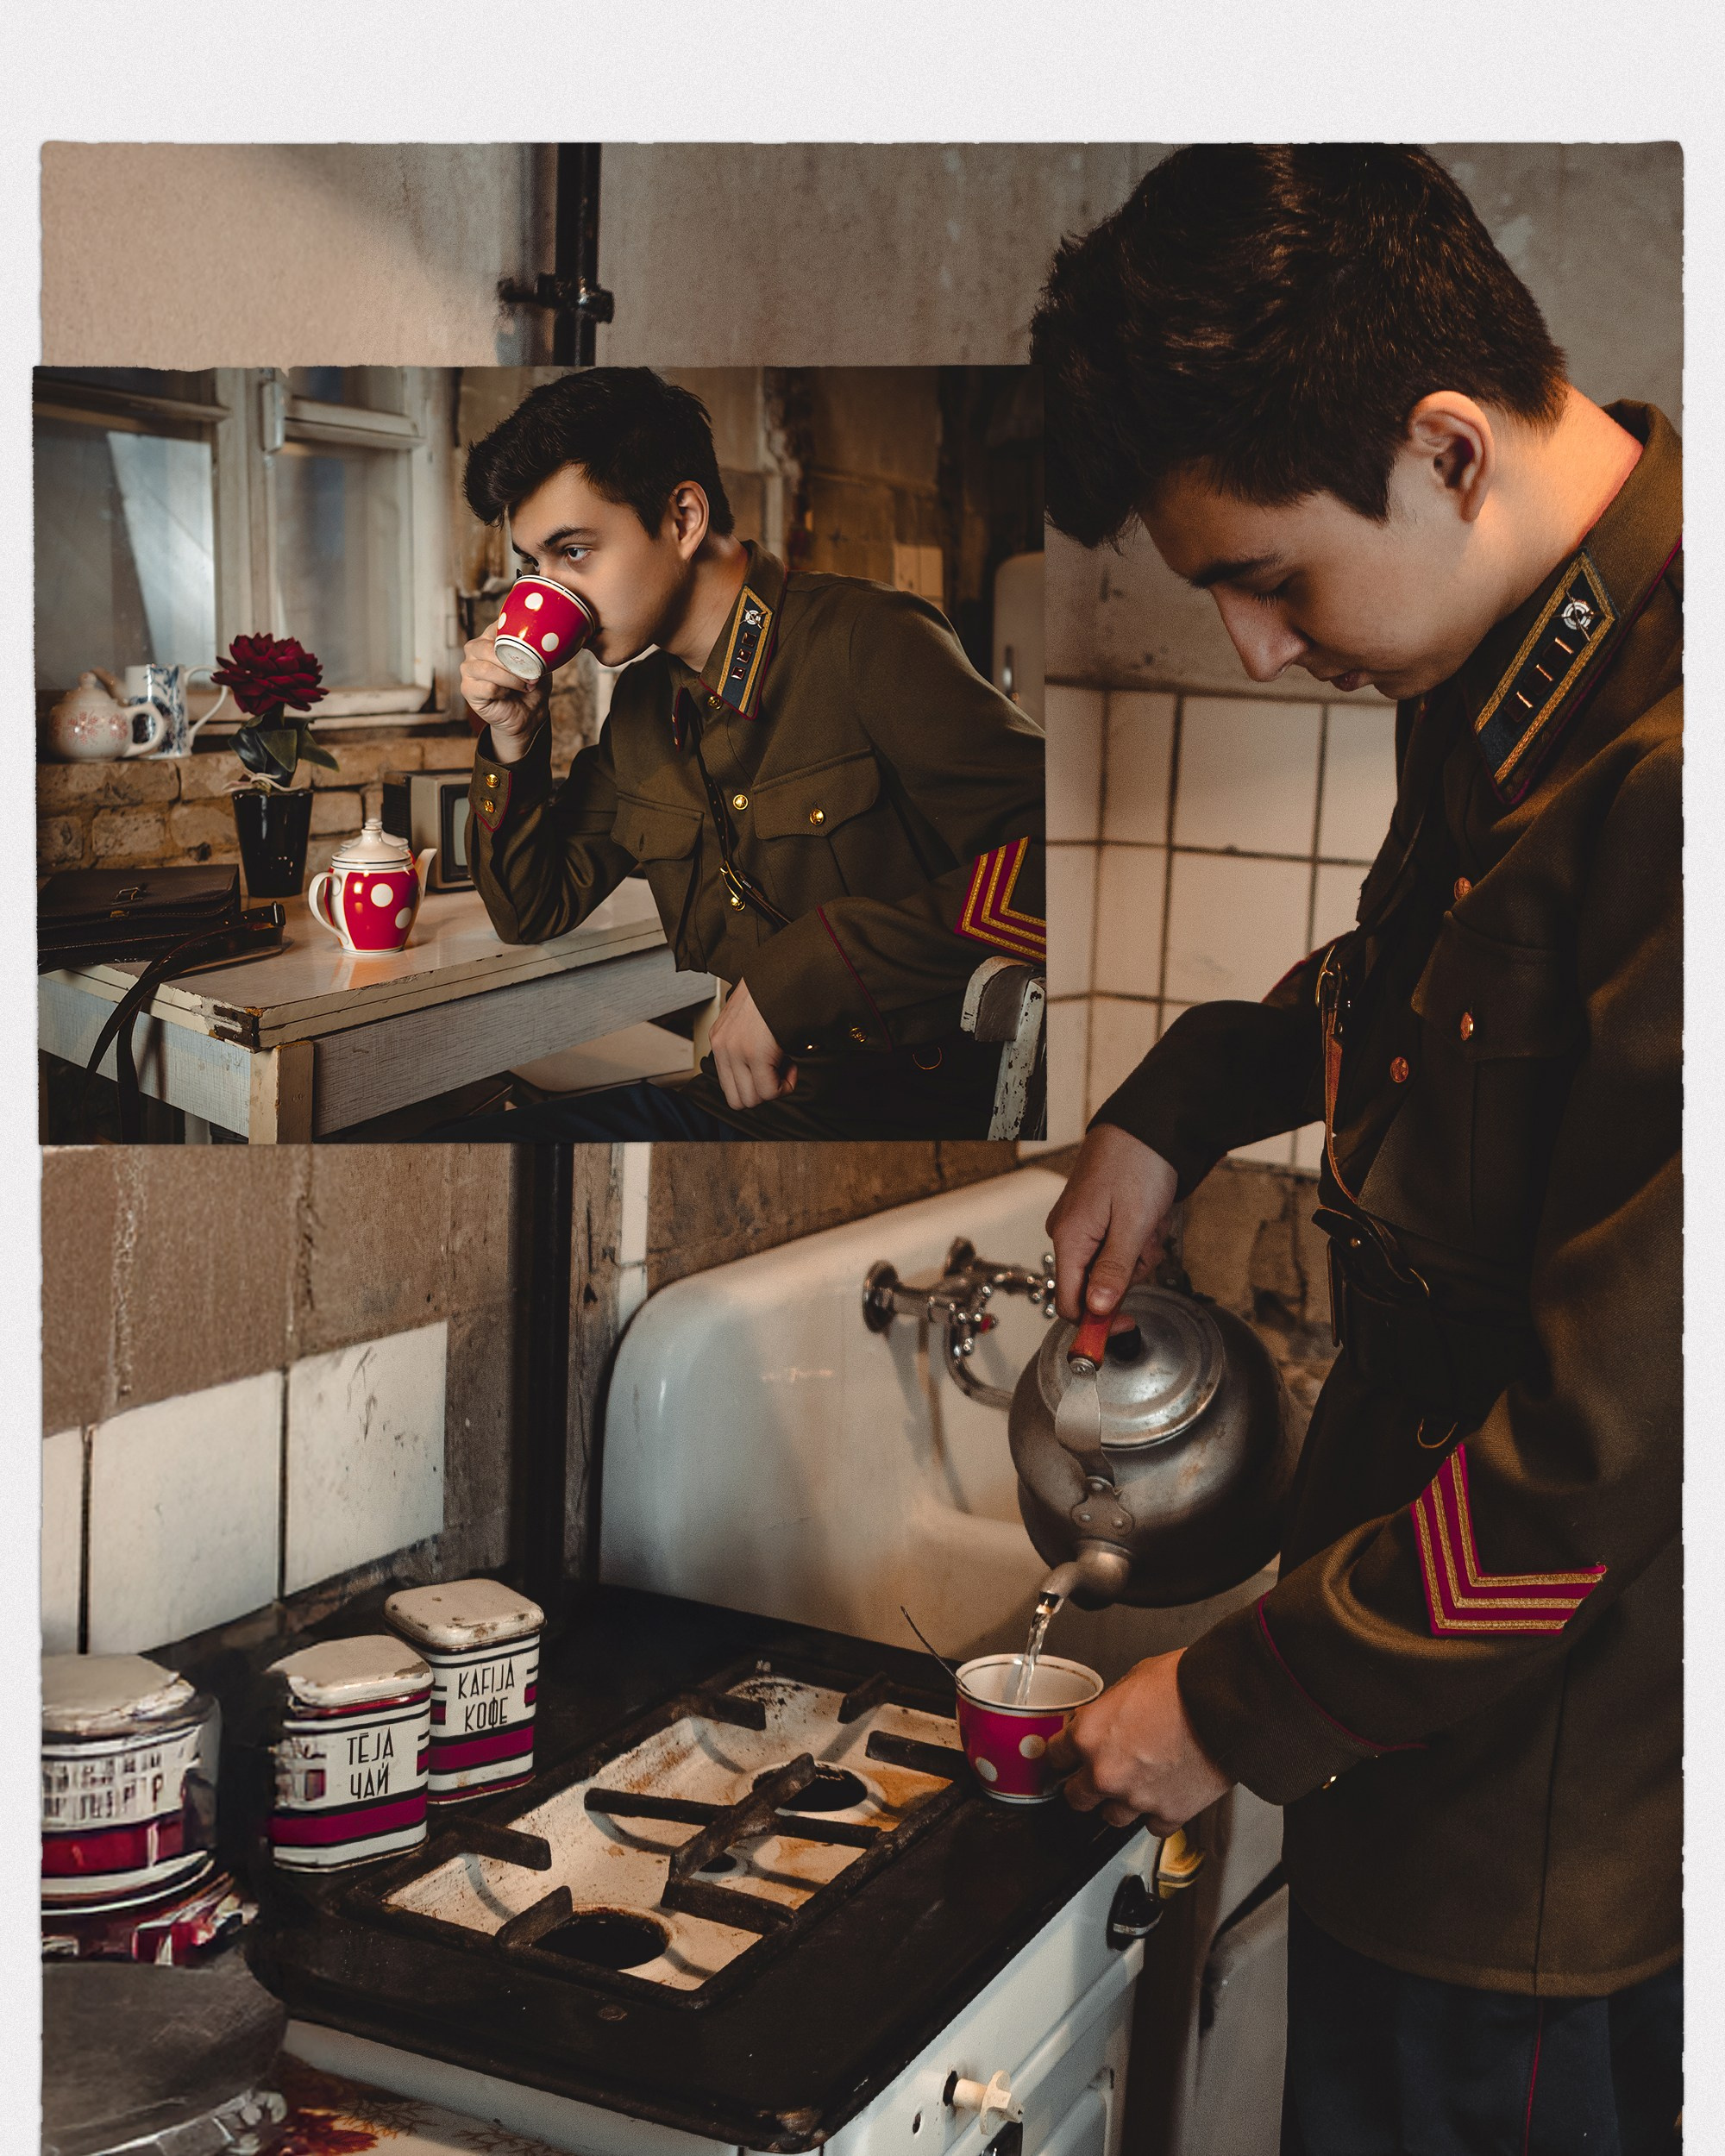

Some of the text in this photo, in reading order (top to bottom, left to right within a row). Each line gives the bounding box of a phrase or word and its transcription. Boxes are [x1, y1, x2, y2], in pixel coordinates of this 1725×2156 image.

[458, 1657, 515, 1699] KAFIJA
[464, 1696, 508, 1732] КОФЕ
[347, 1726, 394, 1764] TĒJA
[350, 1762, 389, 1799] ЧАЙ
